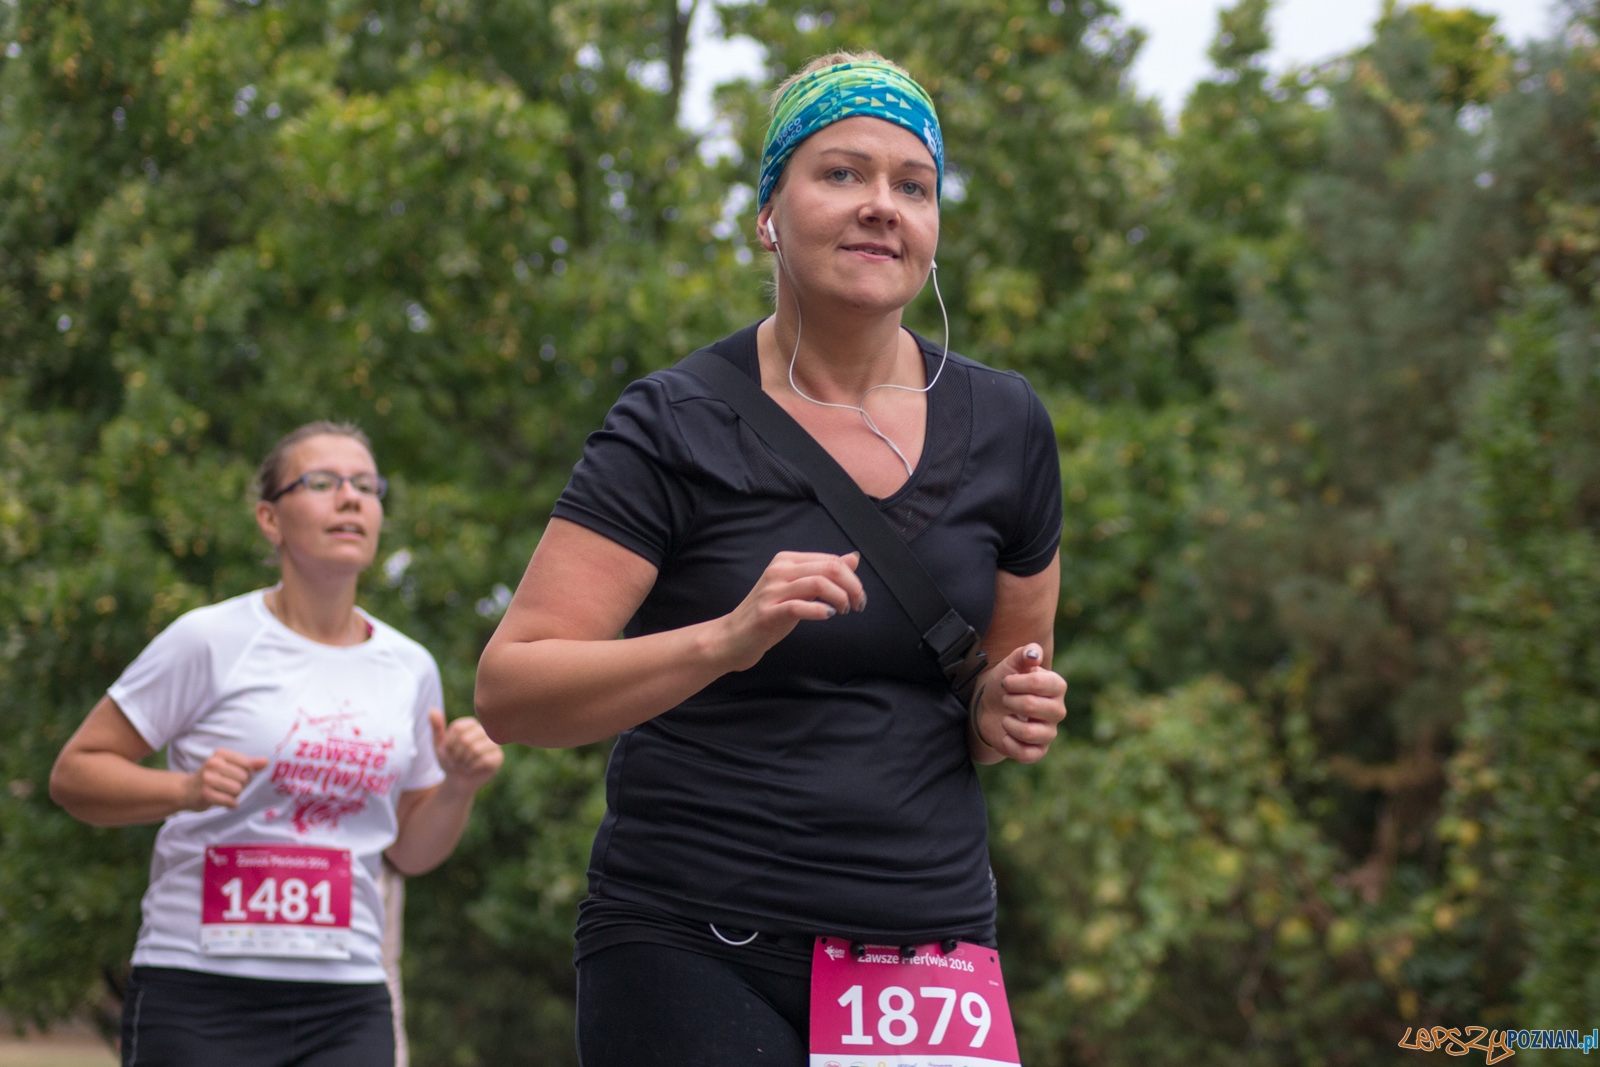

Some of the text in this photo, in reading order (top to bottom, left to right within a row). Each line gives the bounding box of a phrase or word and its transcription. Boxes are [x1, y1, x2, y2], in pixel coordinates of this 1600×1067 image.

[295, 740, 387, 770] zawsze
[221, 877, 335, 924] 1481
[949, 957, 975, 973] 2016
[837, 985, 992, 1048] 1879
